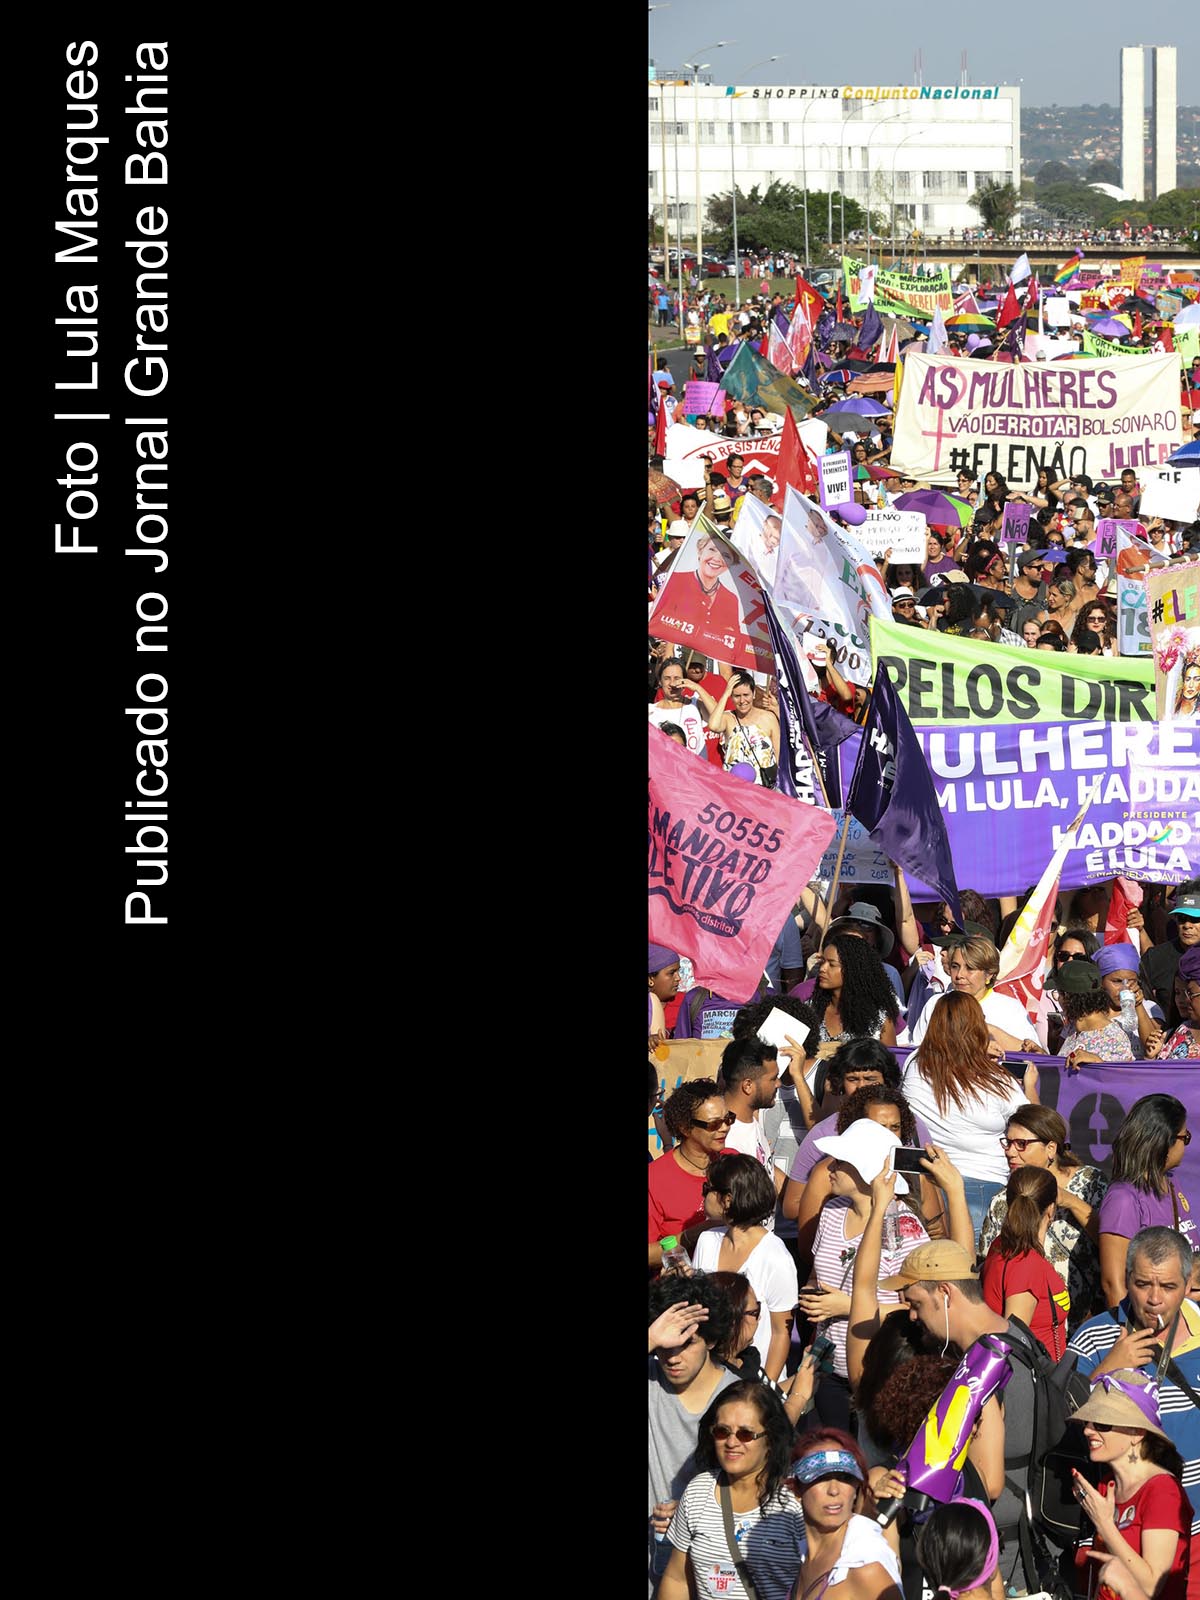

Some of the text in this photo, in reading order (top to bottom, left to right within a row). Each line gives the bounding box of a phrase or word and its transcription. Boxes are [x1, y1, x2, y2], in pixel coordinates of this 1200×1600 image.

[752, 88, 839, 99] SHOPPING
[918, 366, 1118, 410] AS MULHERES
[949, 410, 1177, 437] VÃO DERROTAR BOLSONARO
[823, 465, 848, 475] FEMINISTA
[827, 481, 847, 493] VIVE!
[1004, 520, 1028, 539] NÃO
[660, 614, 694, 634] LULA 13
[878, 655, 1042, 721] PELOS
[965, 778, 1068, 813] LULA,
[697, 802, 785, 853] 50555
[1122, 811, 1188, 819] PRESIDENTE
[652, 807, 772, 884] MANDATO
[1052, 820, 1192, 851] HADDAD
[1108, 846, 1192, 872] LULA
[701, 915, 735, 935] distrital
